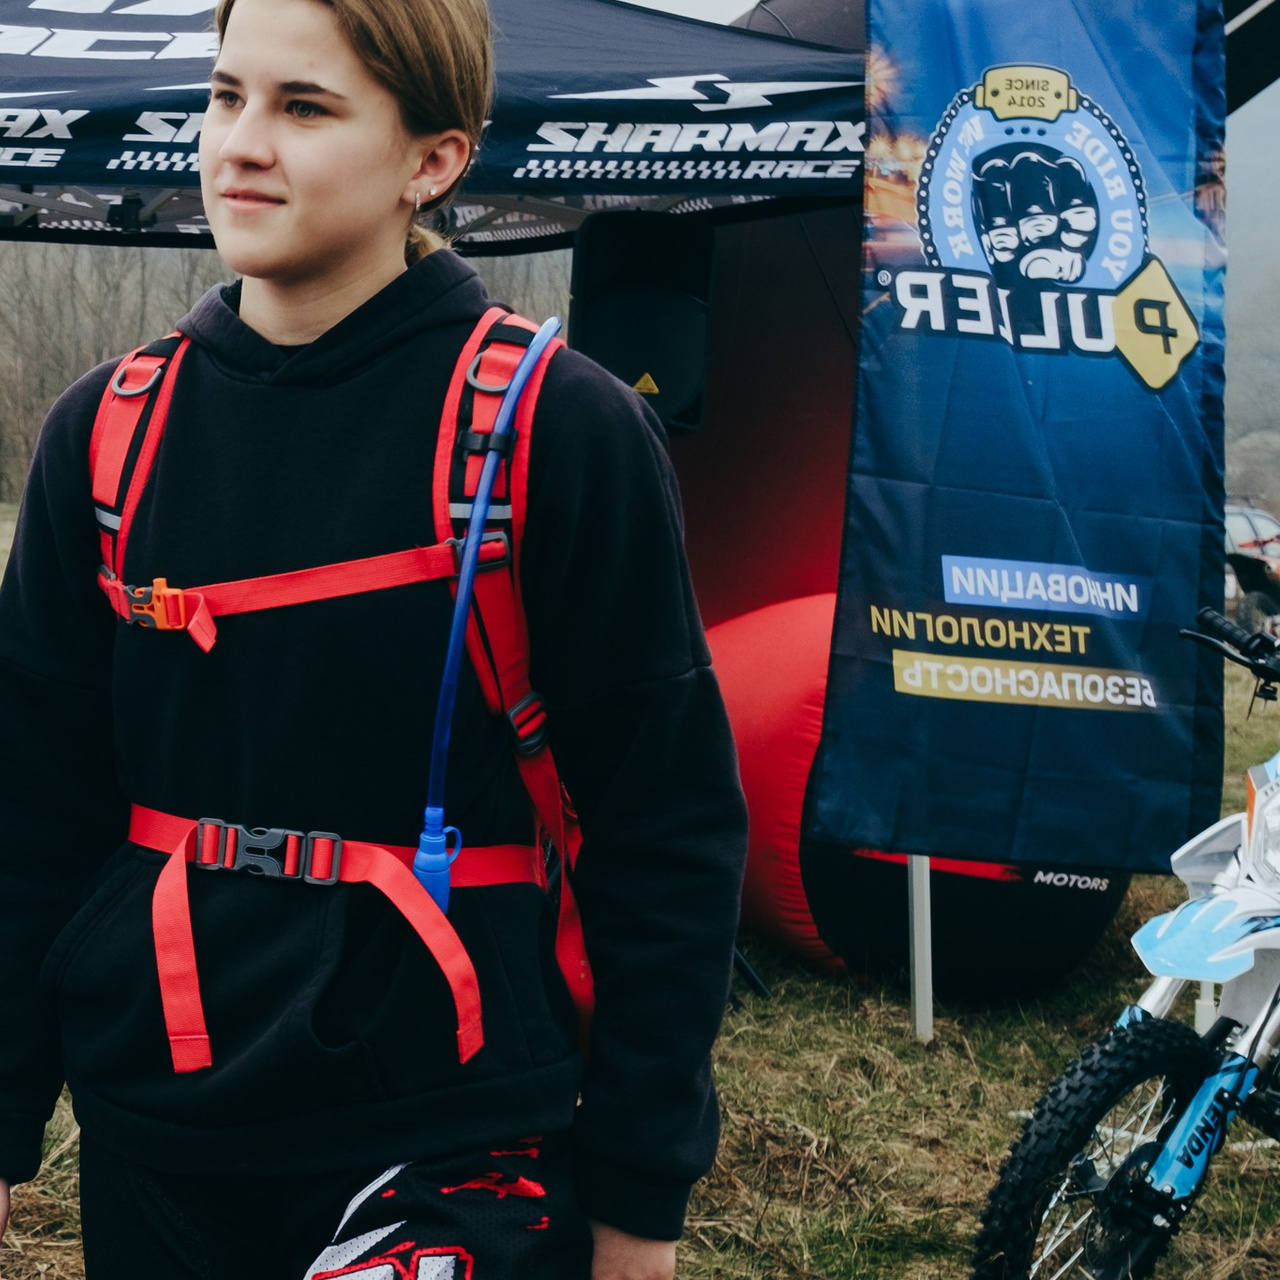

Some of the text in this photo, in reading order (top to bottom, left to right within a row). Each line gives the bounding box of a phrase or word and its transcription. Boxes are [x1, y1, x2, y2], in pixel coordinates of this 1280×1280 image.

[526, 121, 866, 153] SHARMAX
[742, 160, 861, 179] RACE
[1033, 870, 1109, 892] MOTORS
